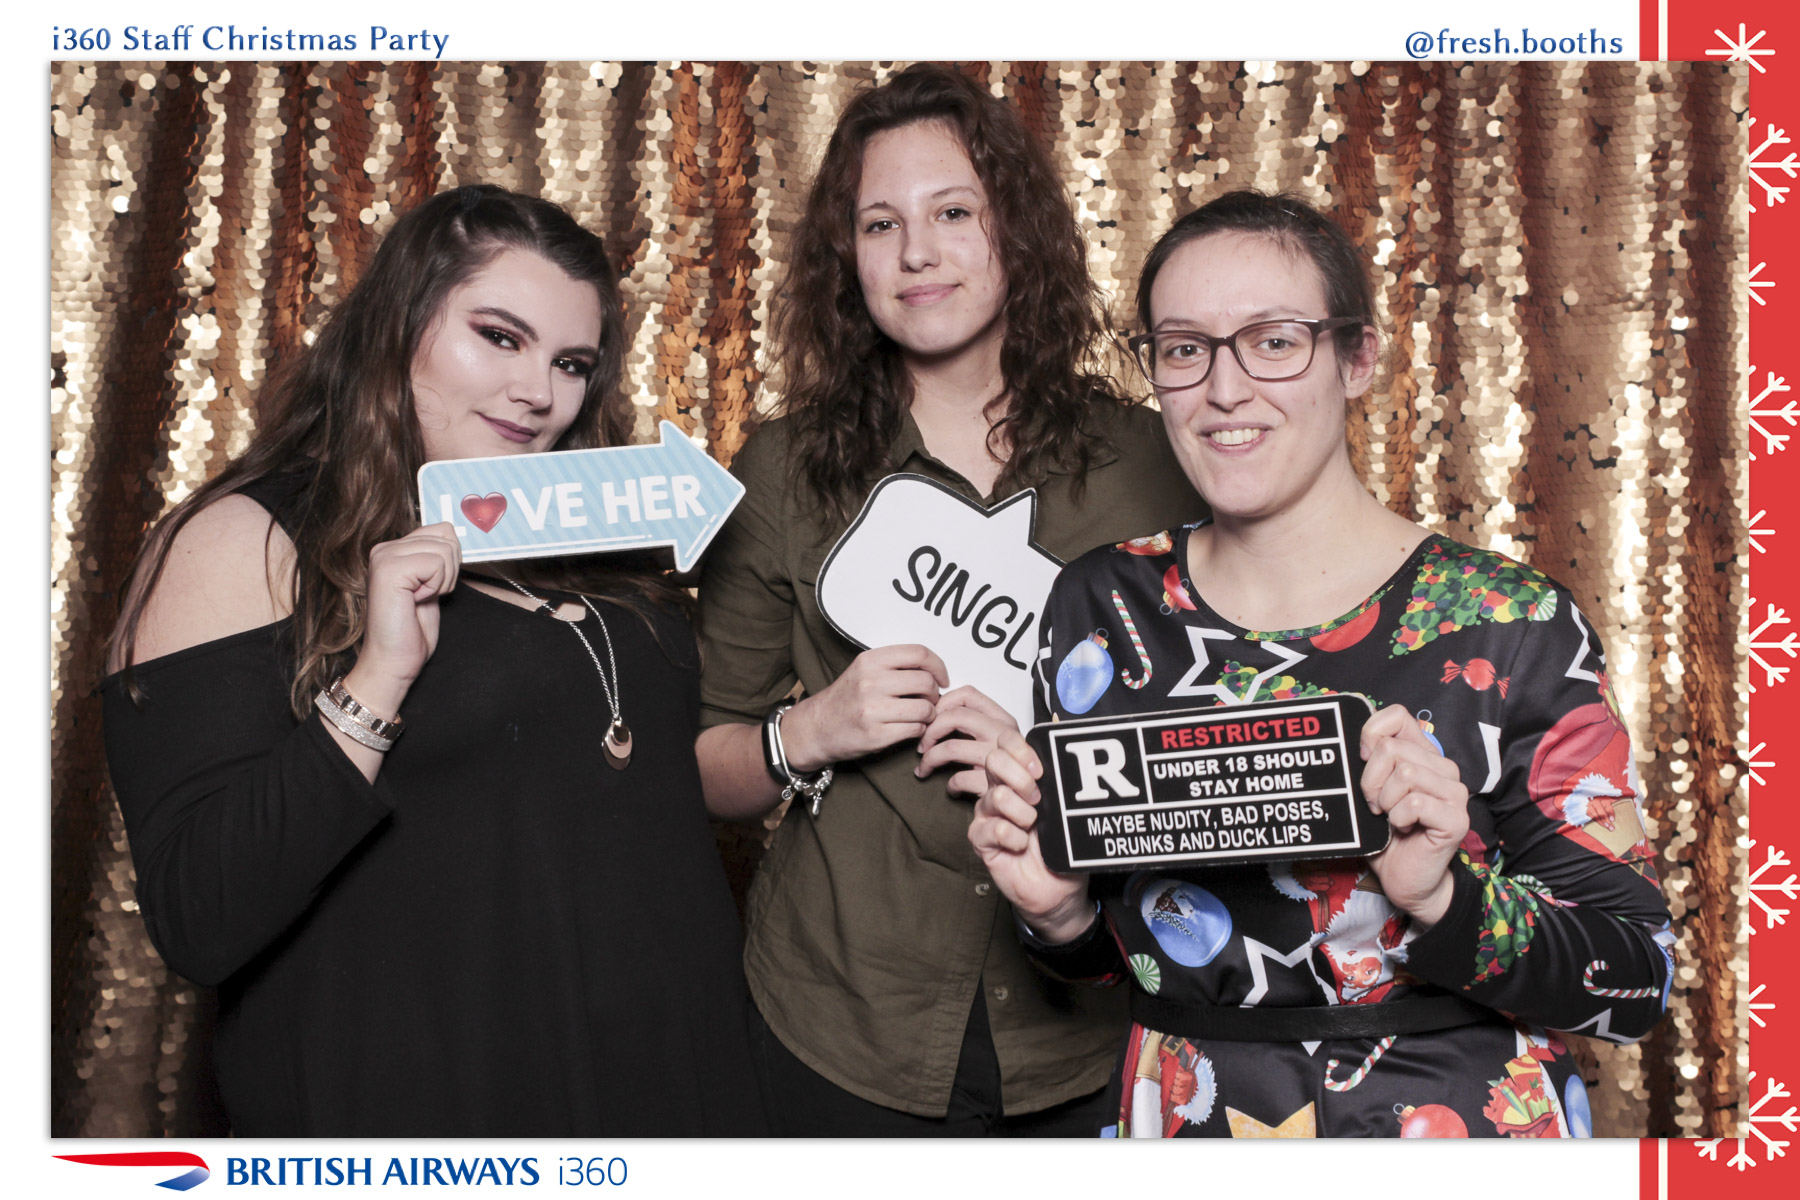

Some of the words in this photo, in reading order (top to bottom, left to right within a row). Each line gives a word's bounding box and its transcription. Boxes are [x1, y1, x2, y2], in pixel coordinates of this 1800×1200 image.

[602, 475, 707, 525] HER
[892, 545, 1038, 681] SINGL
[1161, 716, 1321, 749] RESTRICTED
[1065, 738, 1140, 801] R
[1153, 758, 1220, 780] UNDER
[1225, 756, 1249, 774] 18
[1253, 749, 1336, 771] SHOULD
[1190, 777, 1240, 797] STAY
[1246, 773, 1304, 792] HOME
[1087, 813, 1147, 836] MAYBE
[1150, 809, 1218, 830] NUDITY,
[1222, 805, 1259, 826] BAD
[1263, 800, 1330, 823] POSES,
[1104, 834, 1175, 857] DRUNKS
[1179, 831, 1216, 852] AND
[1218, 827, 1270, 849] DUCK
[1273, 824, 1312, 845] LIPS
